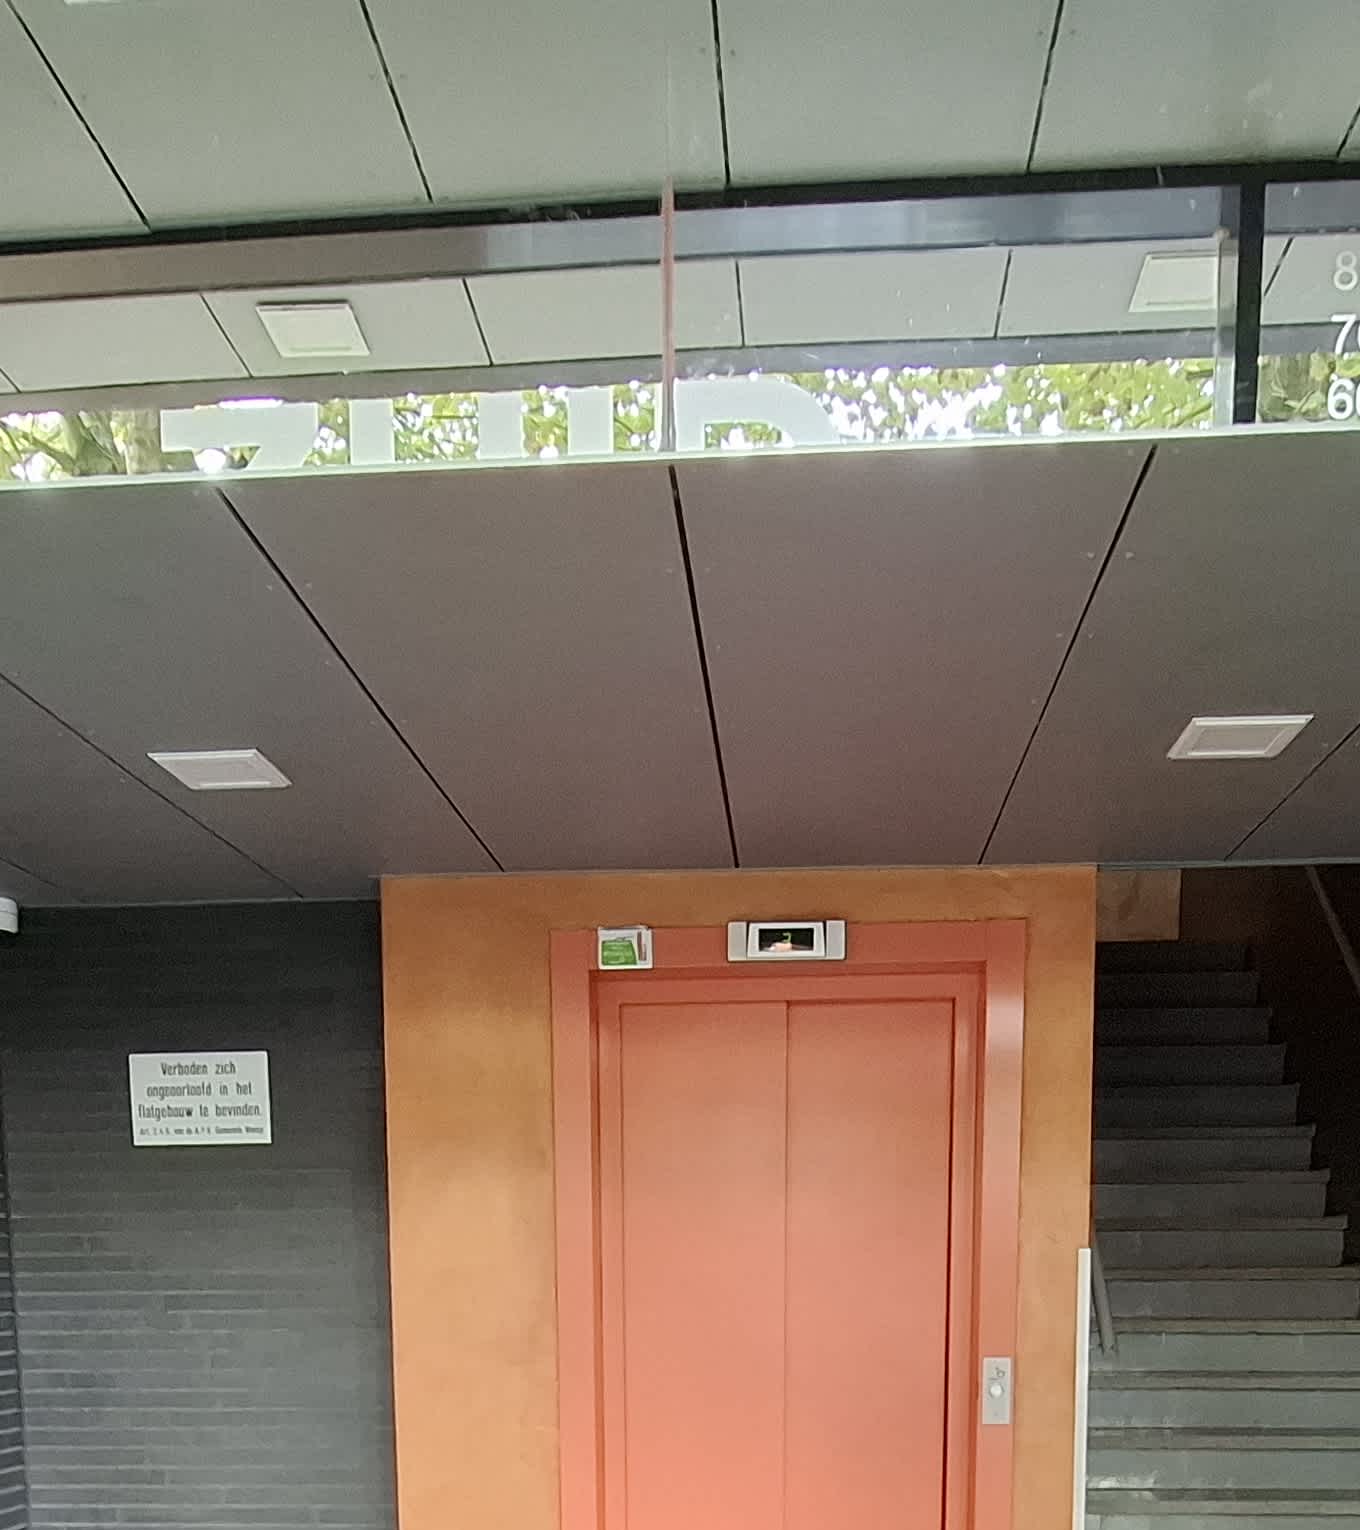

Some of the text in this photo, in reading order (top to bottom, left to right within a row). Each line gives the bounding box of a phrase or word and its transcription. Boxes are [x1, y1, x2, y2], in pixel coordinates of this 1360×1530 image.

[161, 1061, 237, 1076] Verboden zich
[219, 1084, 228, 1095] in
[236, 1082, 252, 1095] het
[138, 1104, 194, 1122] flatgebouw
[199, 1105, 209, 1117] te
